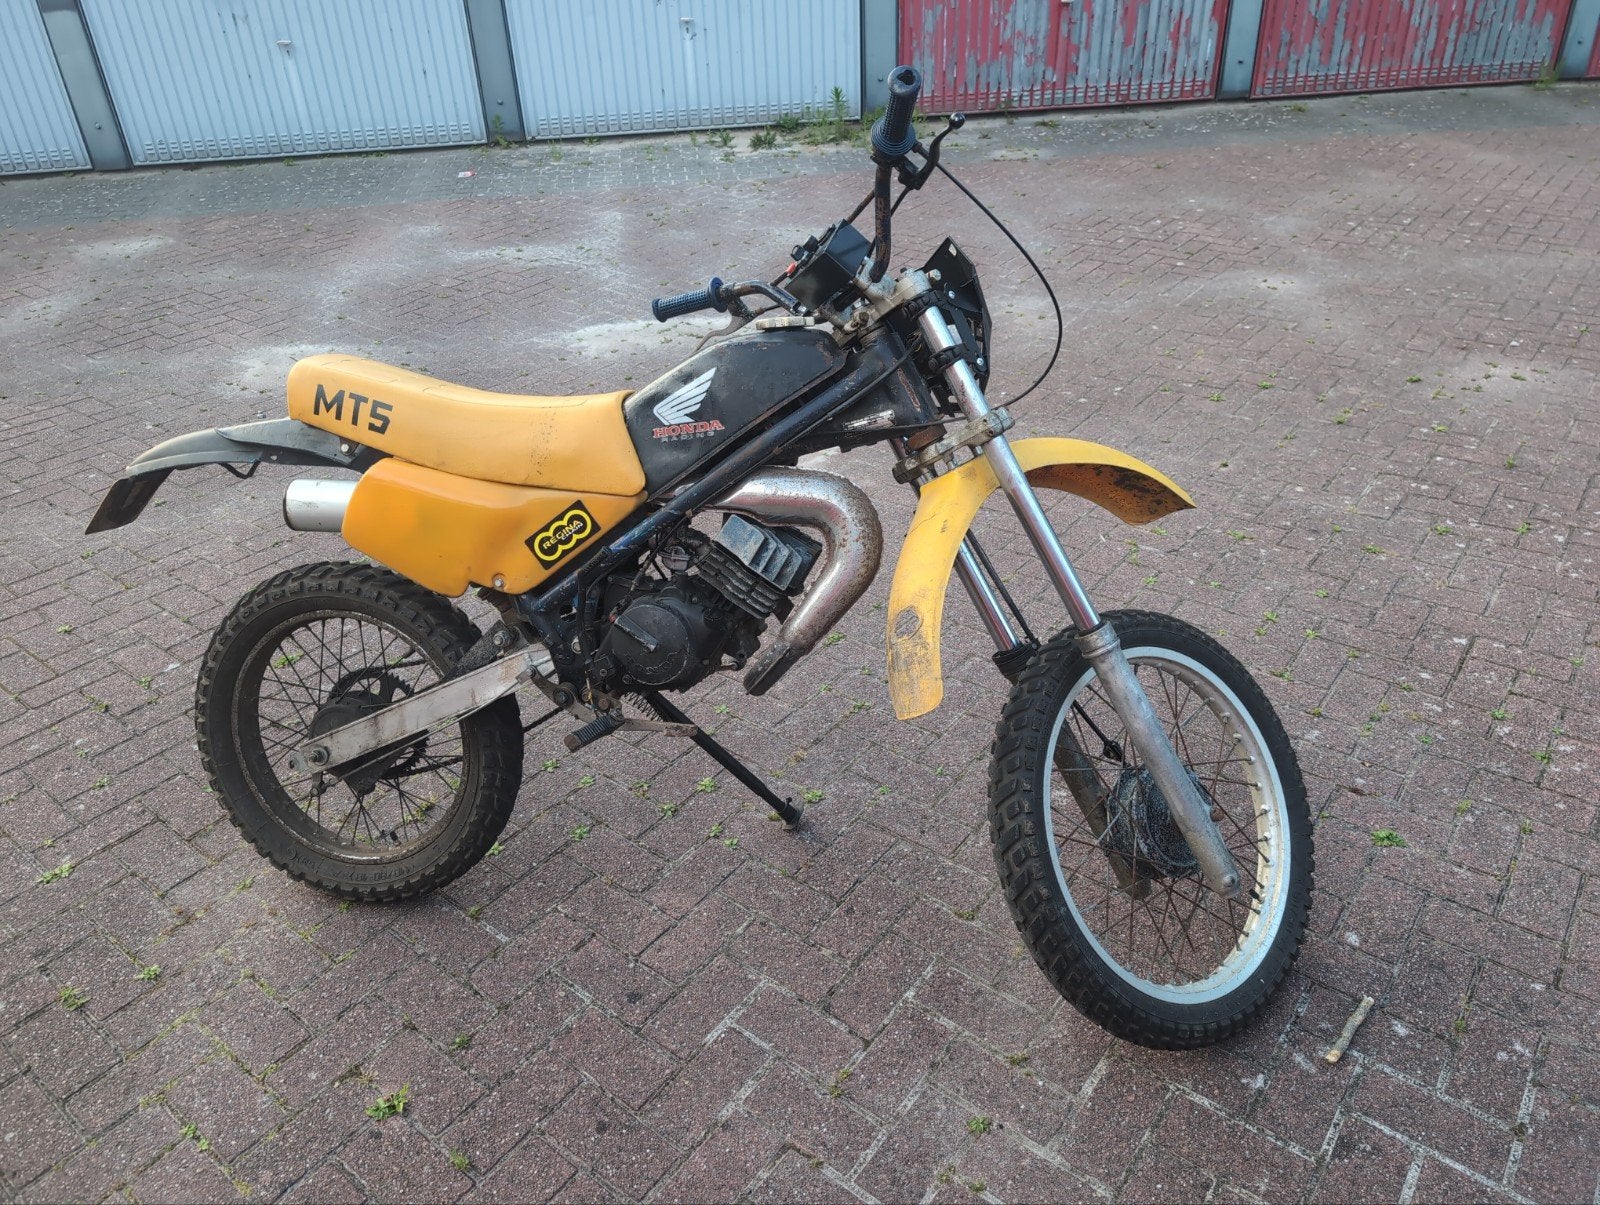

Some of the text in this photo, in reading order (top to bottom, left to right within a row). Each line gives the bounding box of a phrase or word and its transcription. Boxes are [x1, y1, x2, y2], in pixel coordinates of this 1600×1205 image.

[653, 420, 725, 438] HONDA
[661, 431, 715, 443] RACING
[542, 520, 582, 550] REGINA
[561, 523, 584, 541] CHAIN
